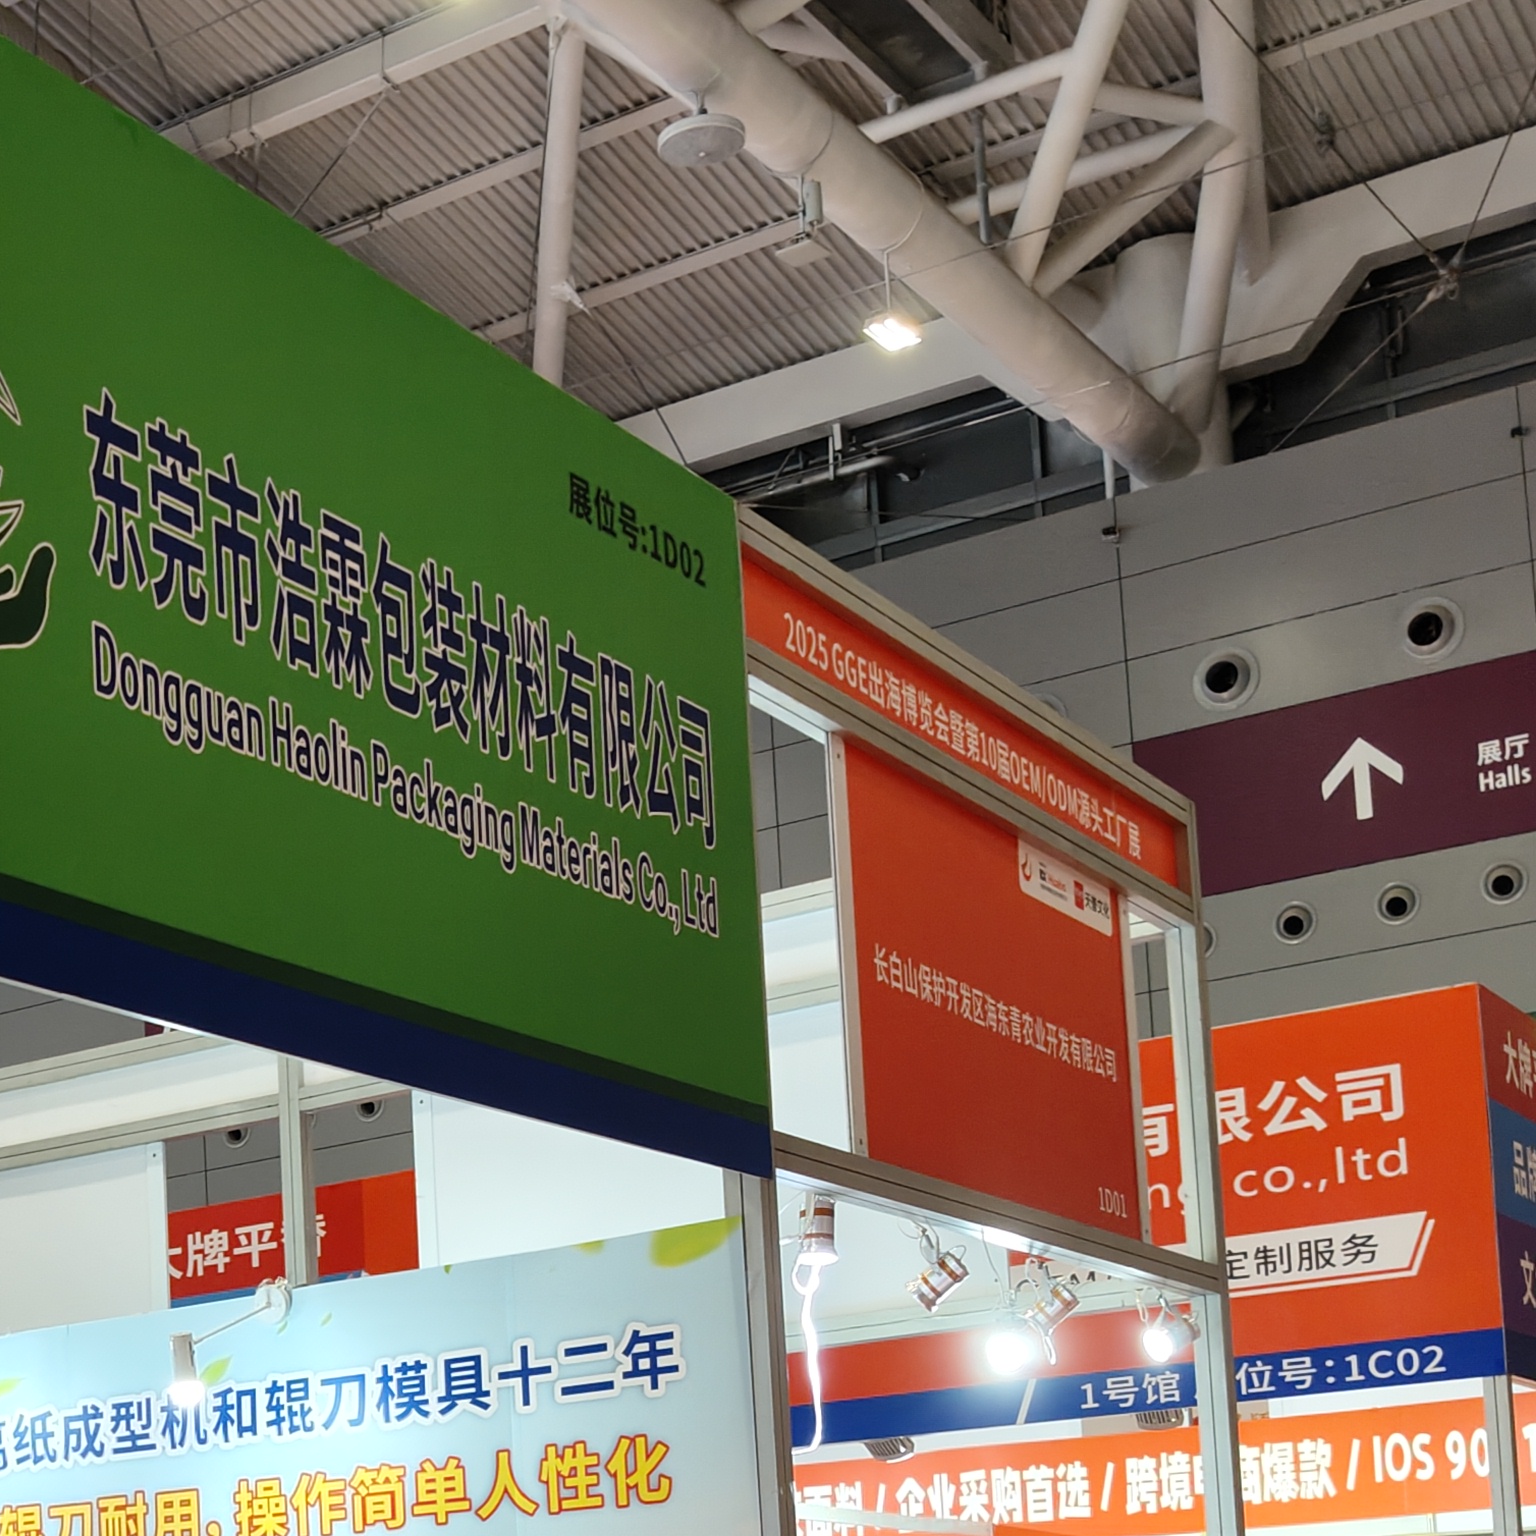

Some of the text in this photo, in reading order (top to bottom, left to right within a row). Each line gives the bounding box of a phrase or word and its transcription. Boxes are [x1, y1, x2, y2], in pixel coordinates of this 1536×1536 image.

[568, 471, 707, 588] 展位号:1D02
[82, 386, 716, 849] 东莞市浩霖包装材料有限公司
[783, 612, 830, 672] 2025
[90, 621, 267, 760] Dongguan
[268, 696, 368, 801] Haolin
[370, 739, 516, 874] Packaging
[518, 801, 635, 905] Materials
[1476, 733, 1530, 767] 展厅
[1478, 764, 1533, 793] Halls
[1502, 1030, 1536, 1099] 大牌
[1098, 1186, 1128, 1219] 1D01
[1080, 1344, 1447, 1410] 1号馆 位号：1C02
[1372, 1431, 1436, 1484] IOS
